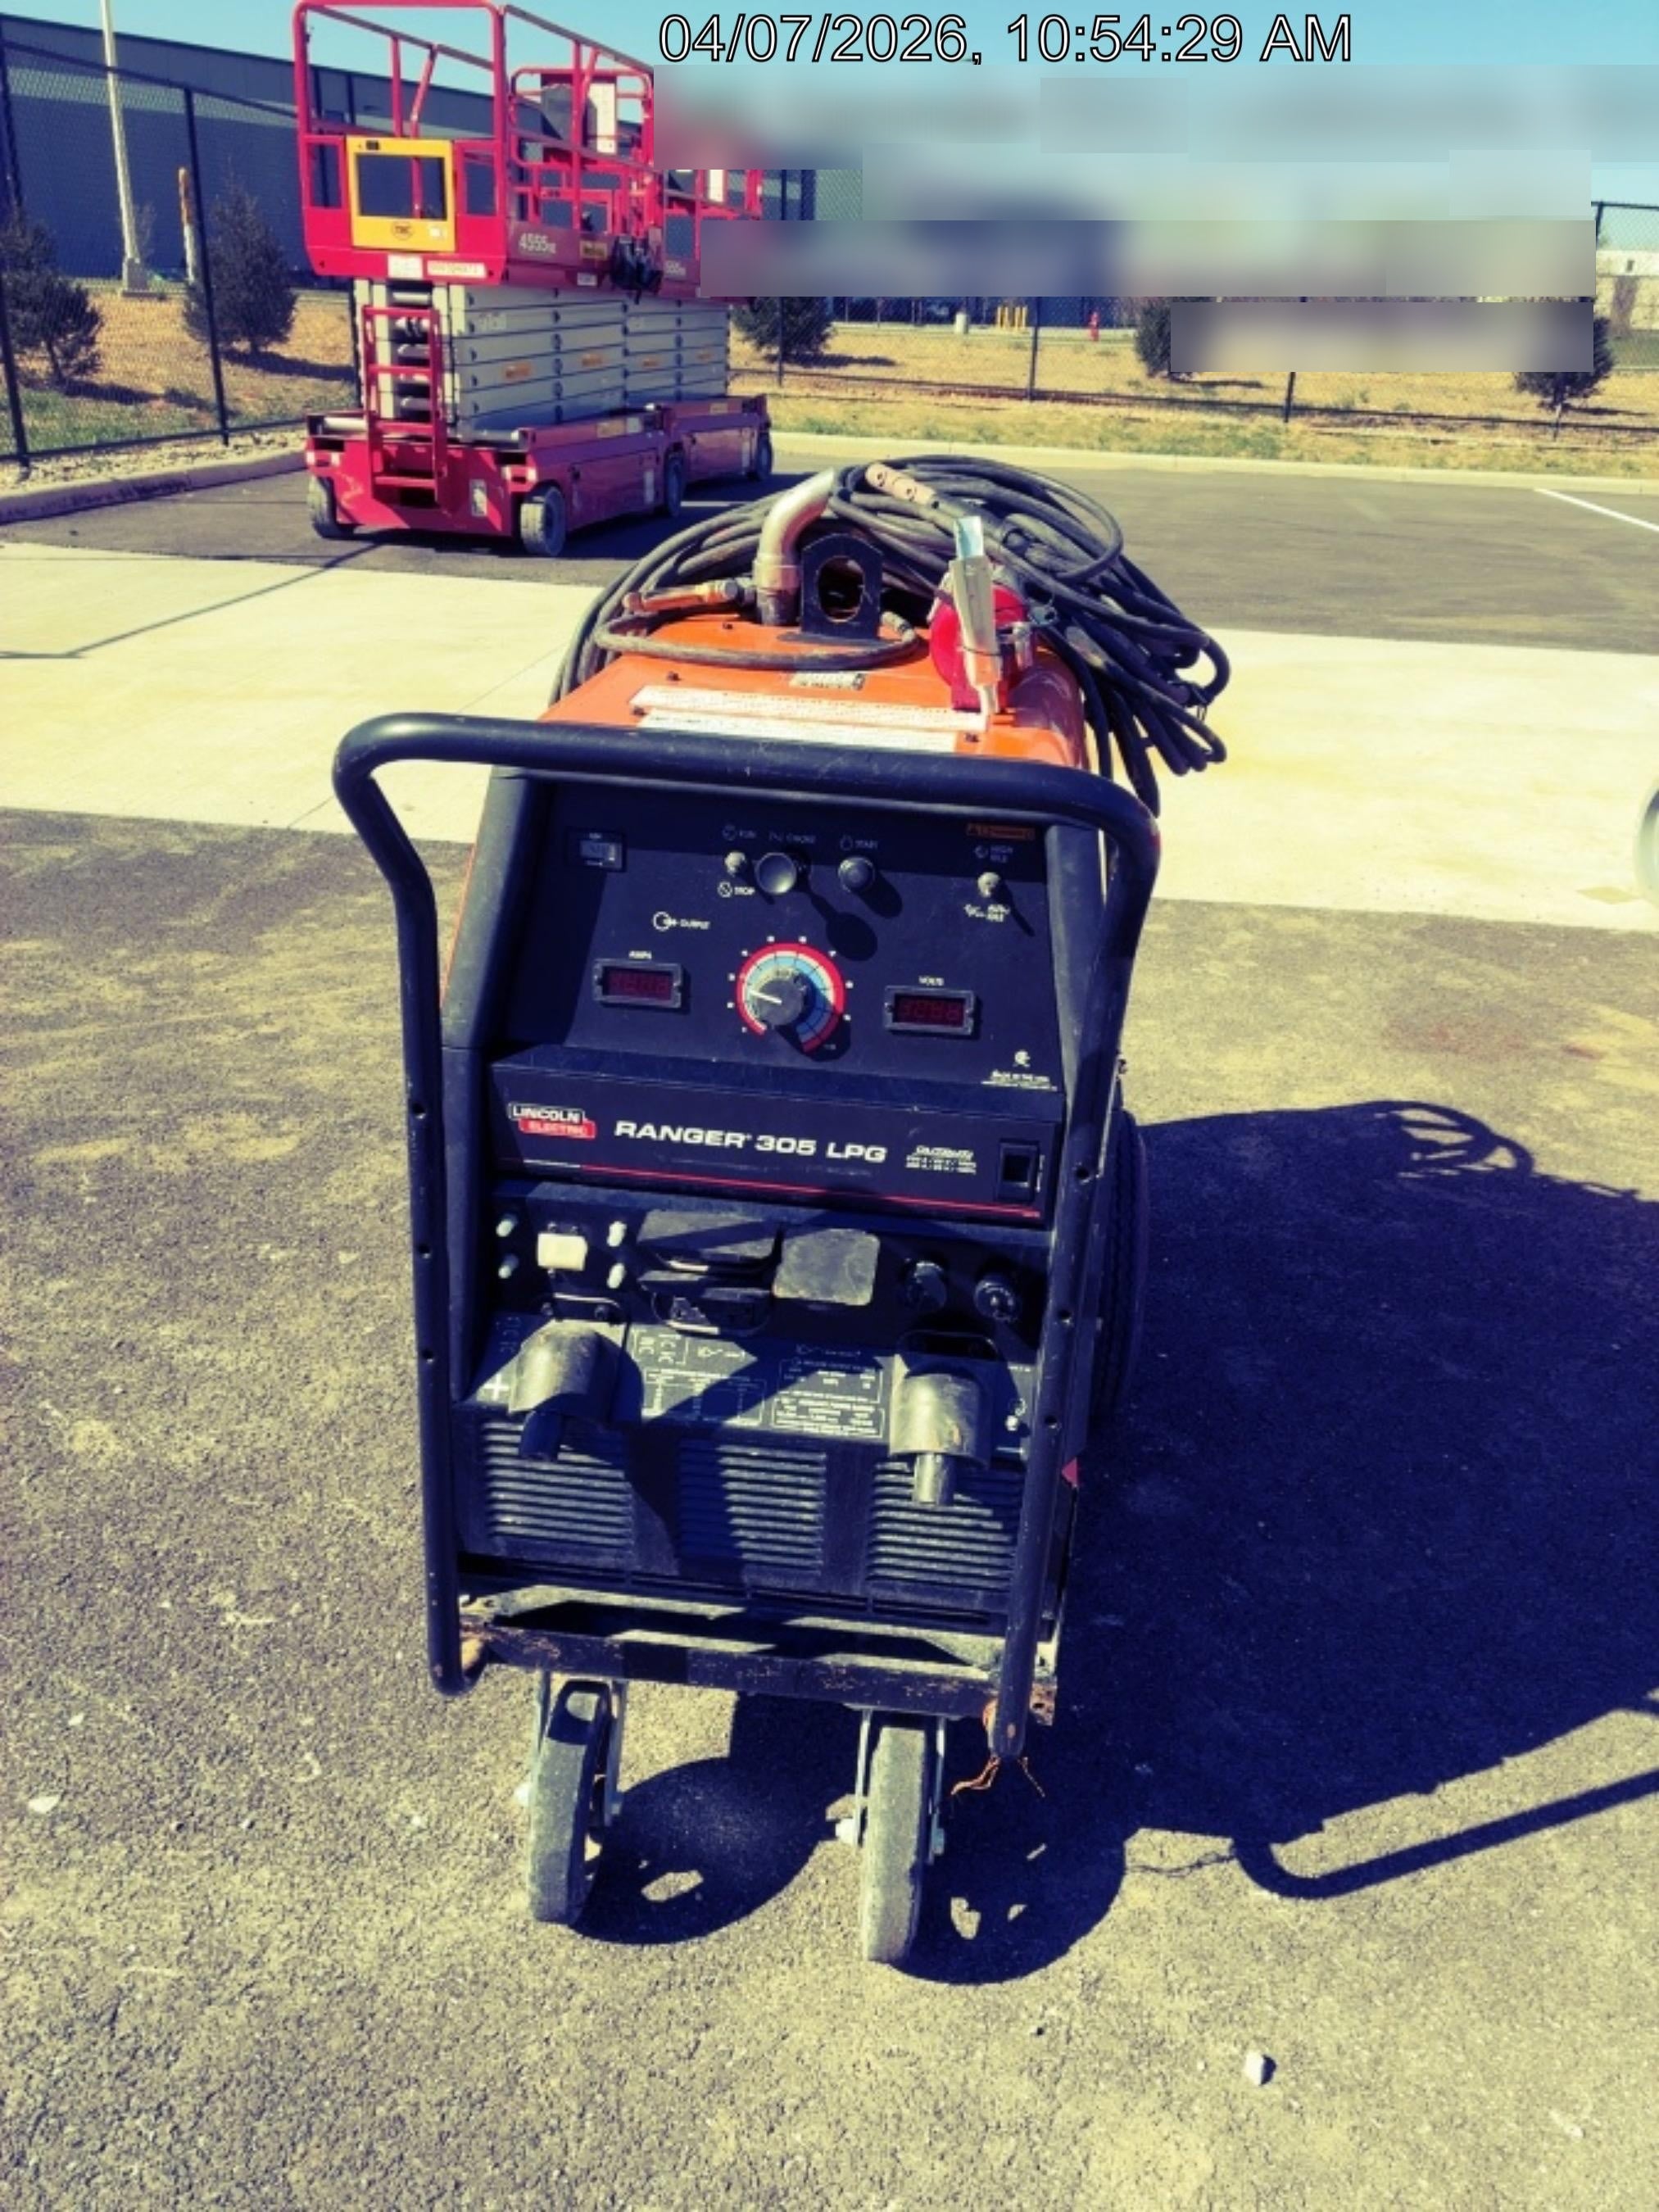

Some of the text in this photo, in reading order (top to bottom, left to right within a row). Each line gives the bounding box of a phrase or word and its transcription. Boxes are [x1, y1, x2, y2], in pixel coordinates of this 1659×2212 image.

[512, 1105, 581, 1124] LINCOLN
[755, 1135, 817, 1156] 305
[826, 1142, 887, 1163] LPG
